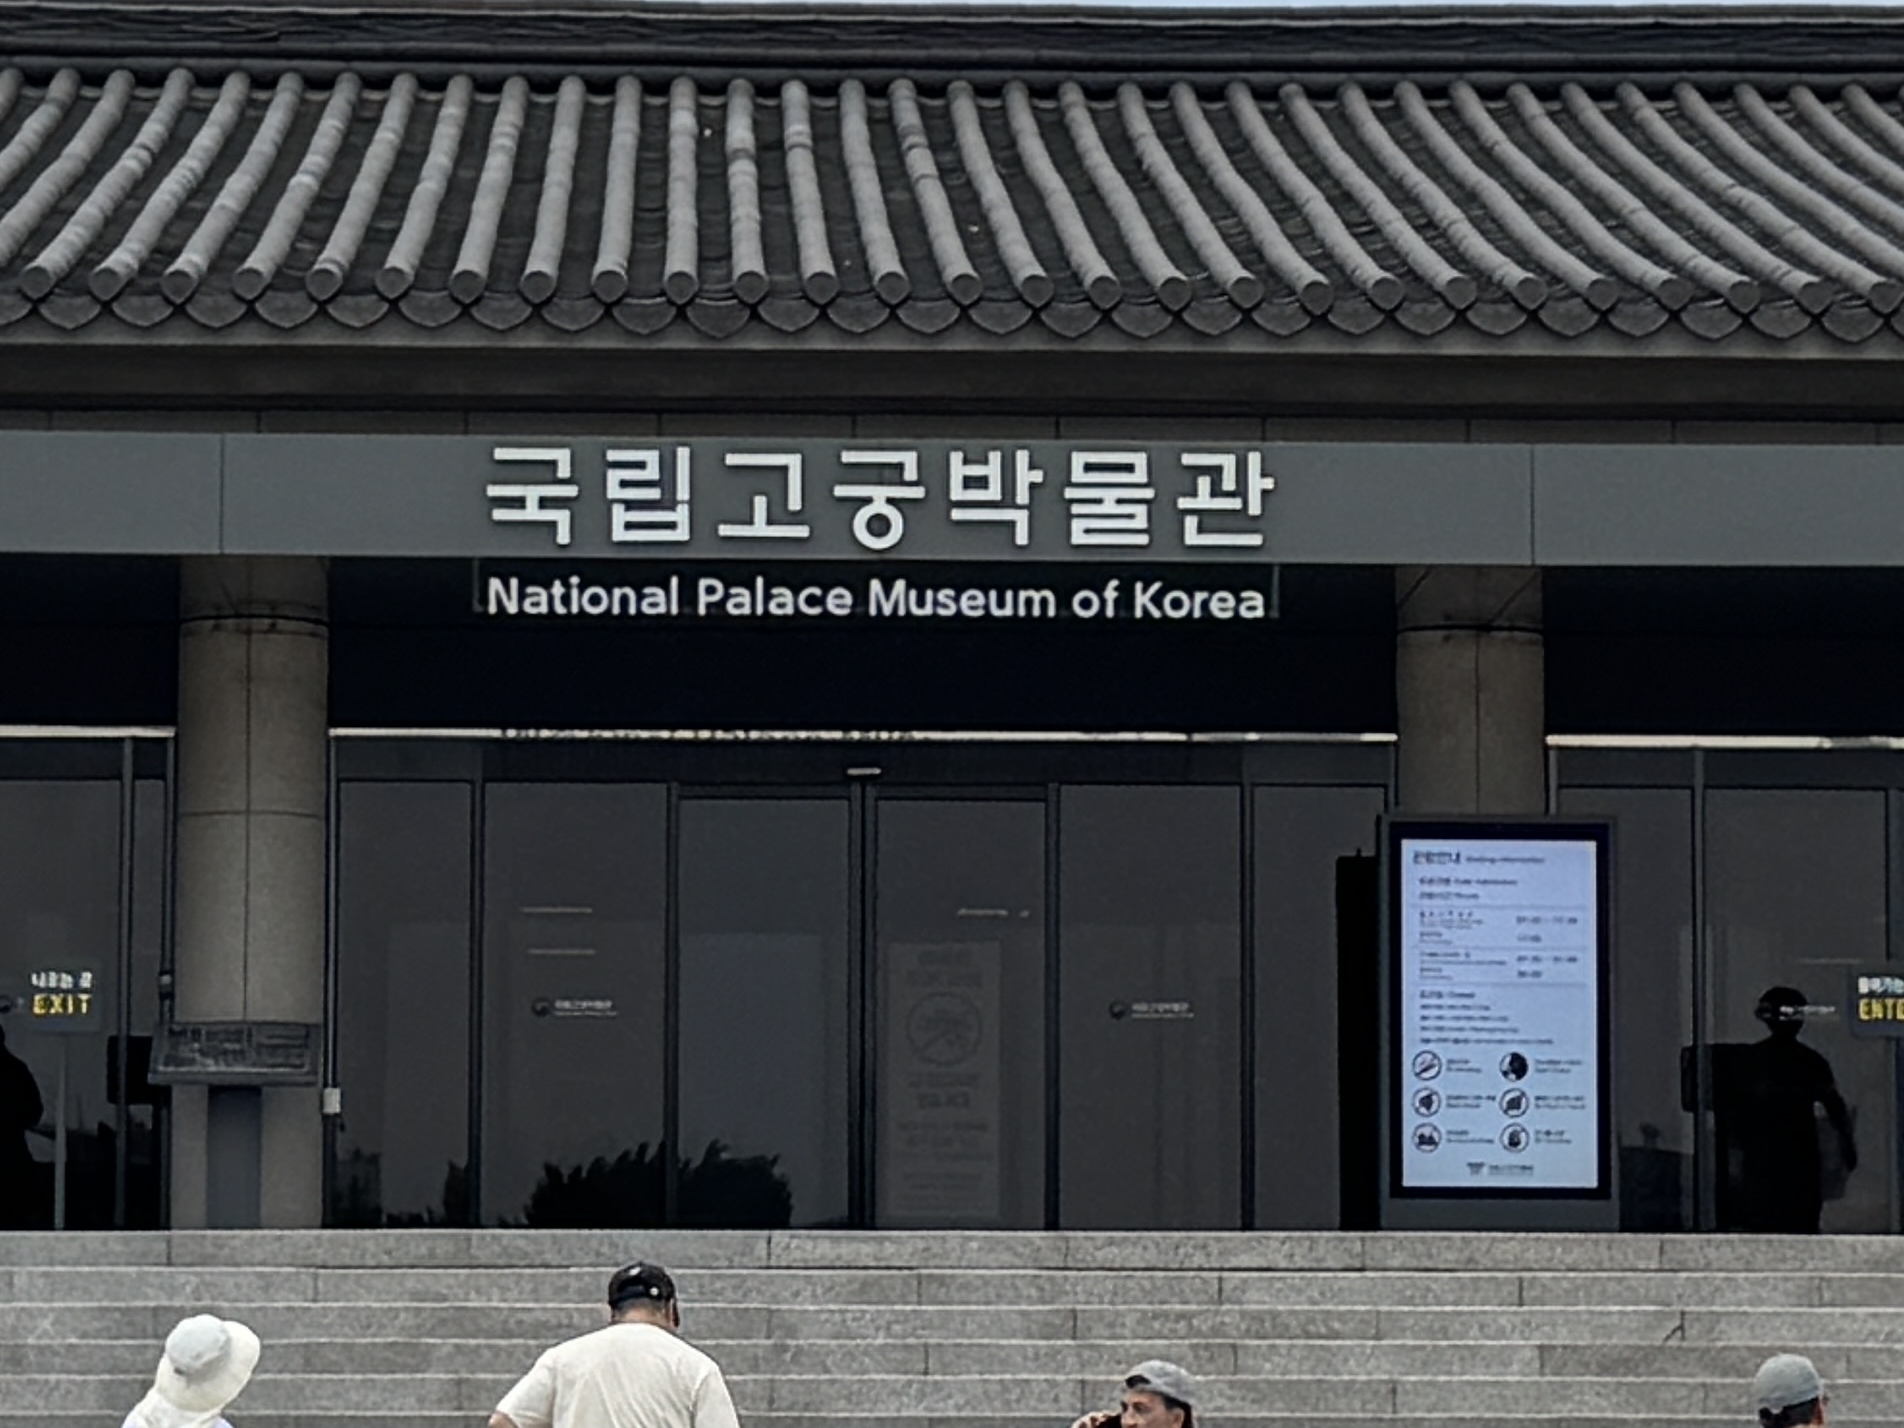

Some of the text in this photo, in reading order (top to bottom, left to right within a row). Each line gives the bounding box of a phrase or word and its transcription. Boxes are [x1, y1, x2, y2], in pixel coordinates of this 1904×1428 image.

[486, 445, 1276, 550] 국립고궁박물관
[487, 575, 1266, 619] National Palace Museum of Korea
[33, 993, 93, 1014] EXIT
